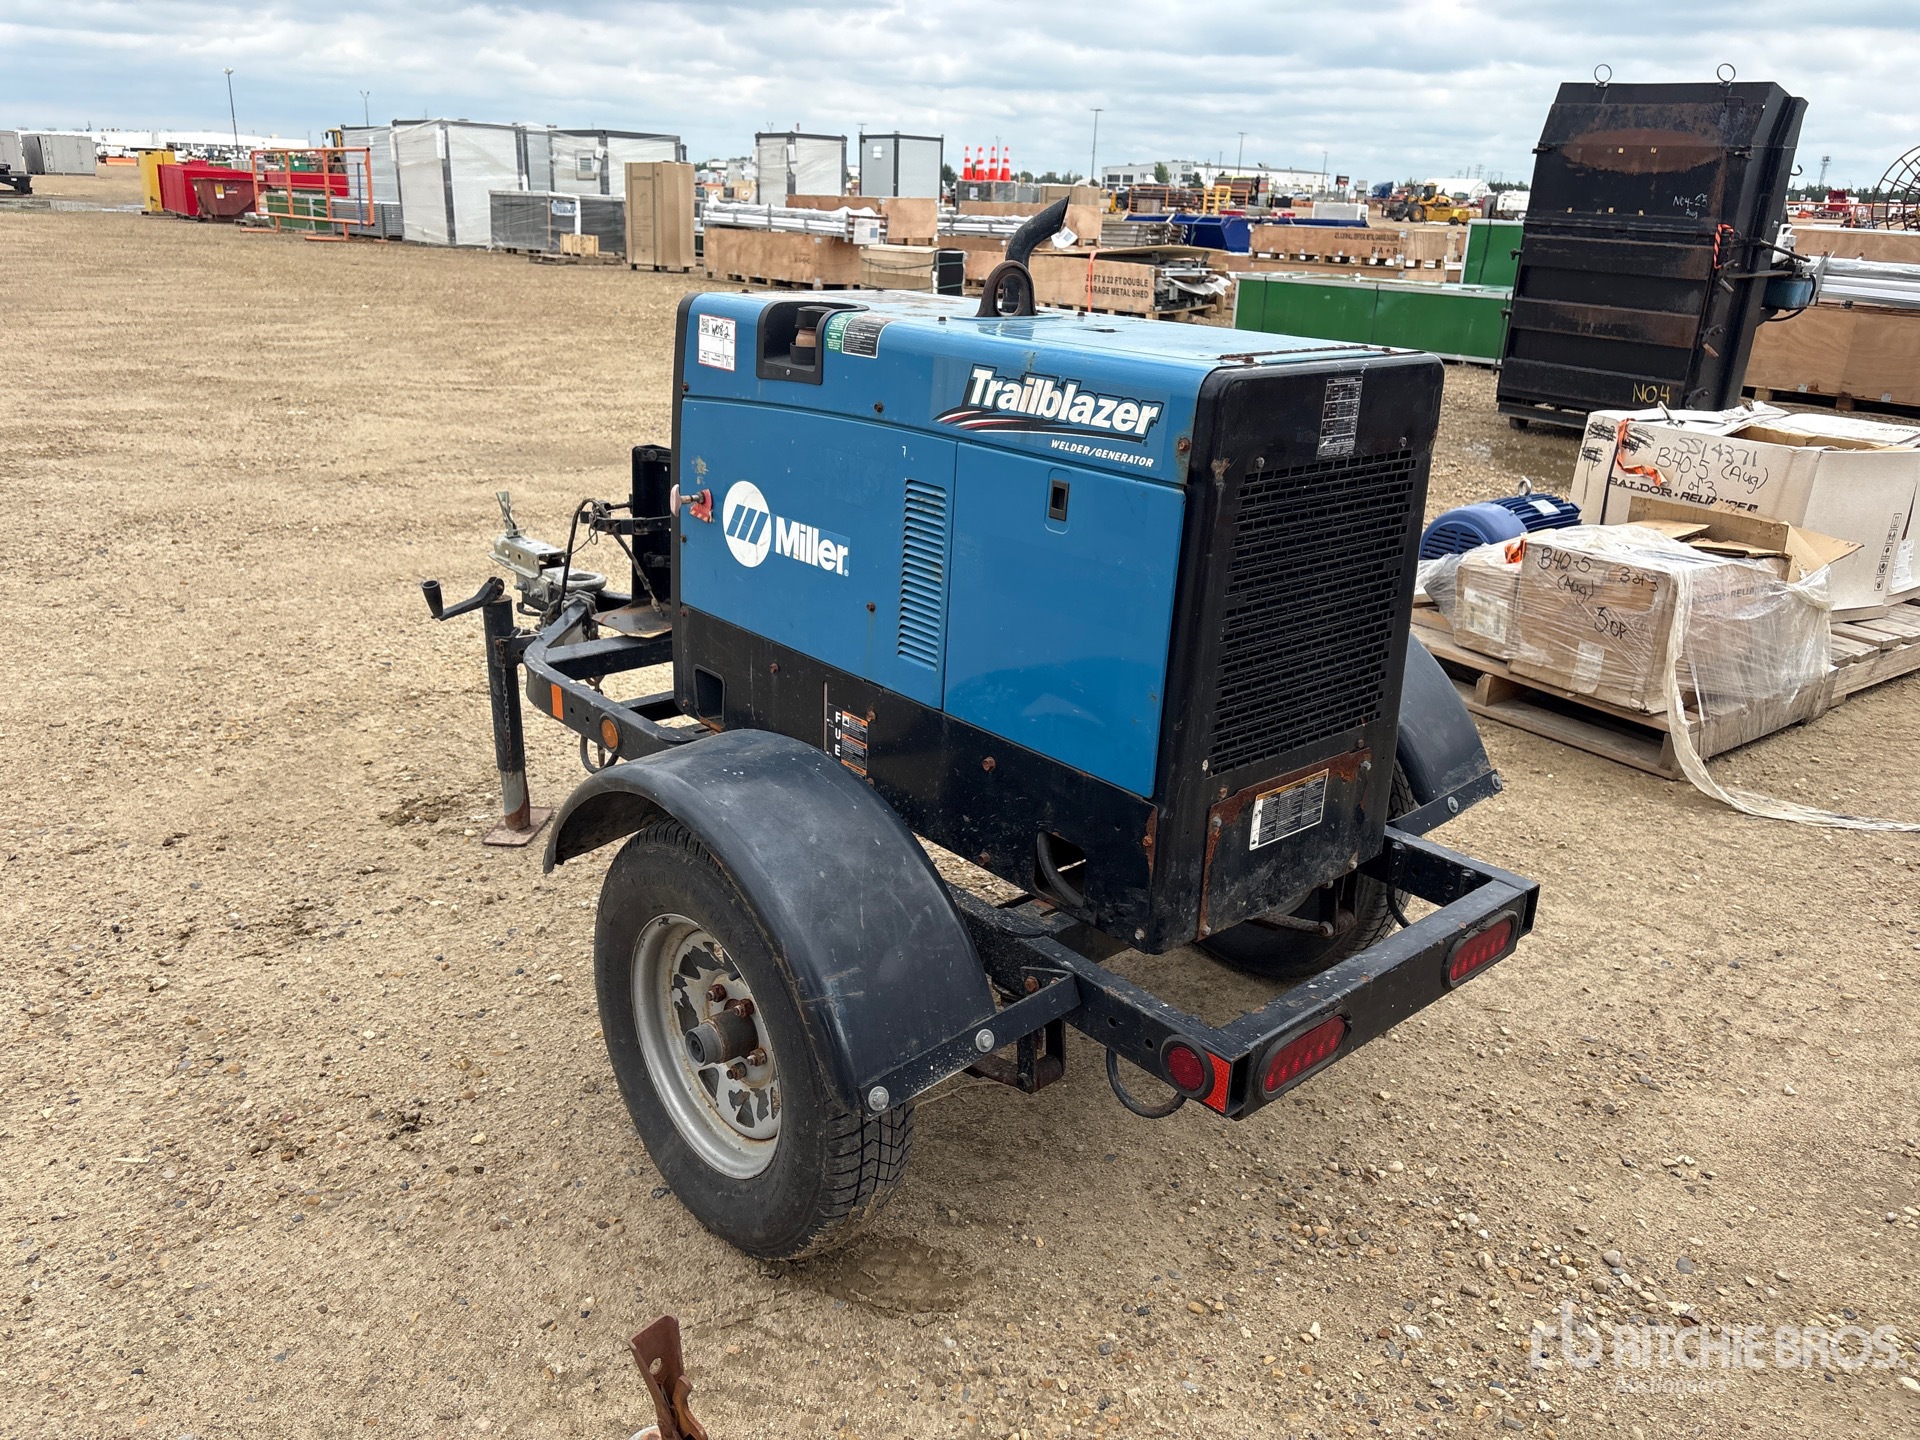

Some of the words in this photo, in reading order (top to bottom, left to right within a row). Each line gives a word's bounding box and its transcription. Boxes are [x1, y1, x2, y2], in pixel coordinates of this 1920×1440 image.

[1111, 287, 1131, 297] METAL
[1132, 289, 1149, 299] SHED
[1123, 277, 1149, 288] DOUBLE
[966, 366, 1161, 436] Trailblazer
[1050, 439, 1155, 468] WELDER/GENERATOR
[1609, 476, 1673, 499] BALDOR
[1688, 476, 1703, 494] of
[1704, 480, 1718, 498] 3
[1721, 462, 1769, 494] (Aug)
[775, 516, 849, 575] Miller
[1619, 566, 1631, 583] 3
[1557, 573, 1594, 606] (Aug)
[1594, 606, 1609, 633] 3
